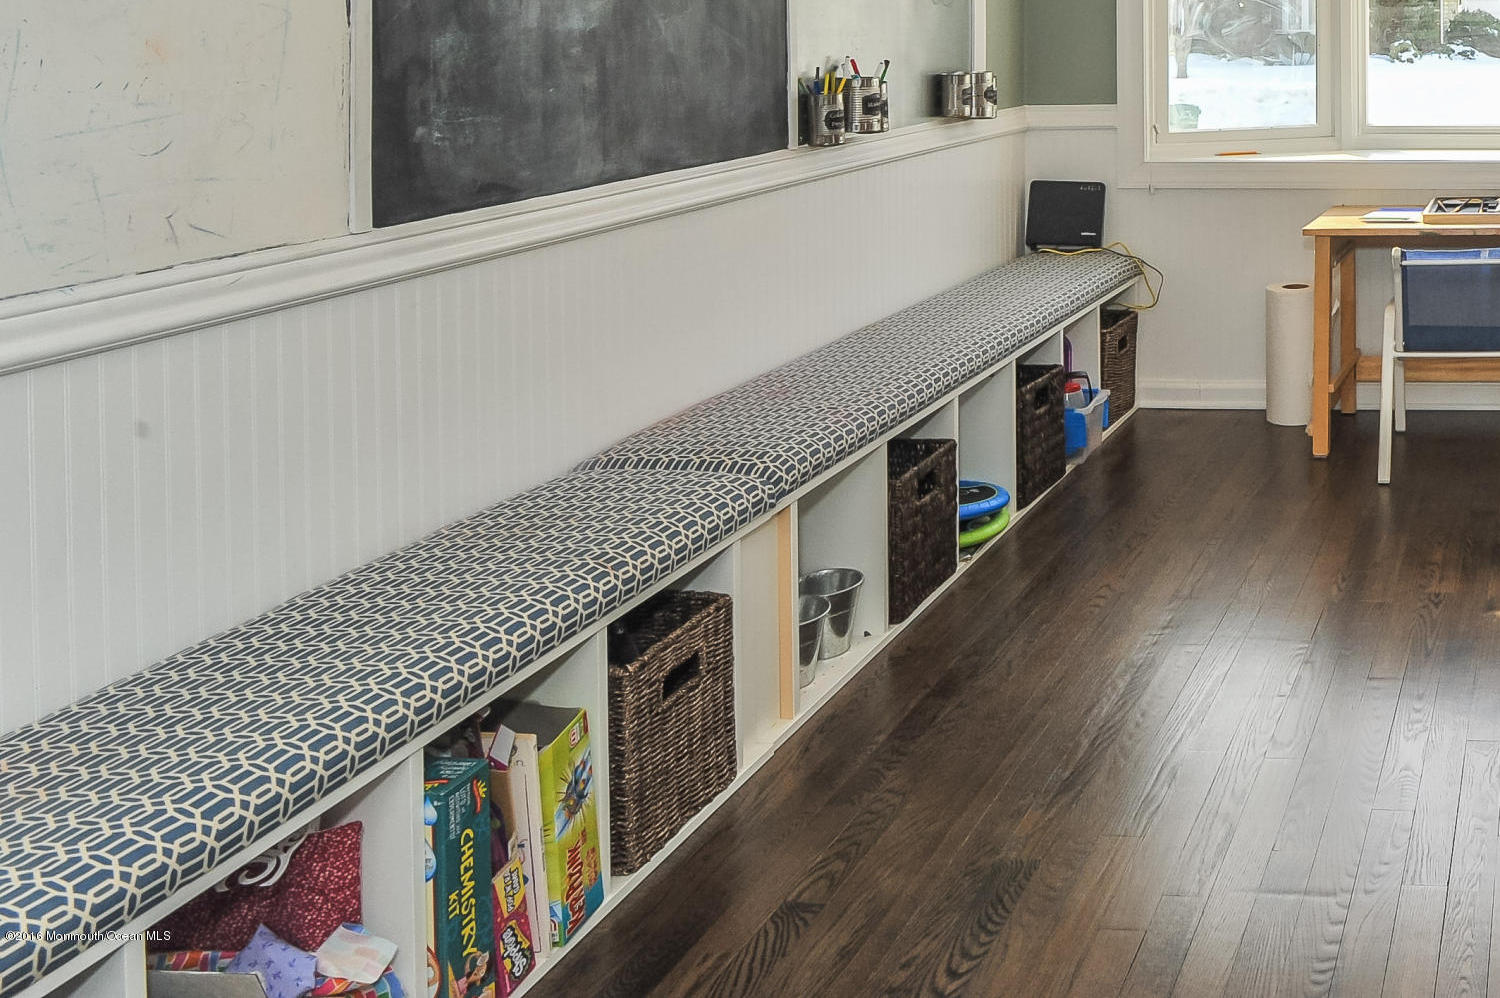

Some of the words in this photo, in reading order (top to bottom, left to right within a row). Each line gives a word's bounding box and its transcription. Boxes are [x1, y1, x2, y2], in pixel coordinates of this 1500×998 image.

[448, 890, 460, 920] KIT
[461, 828, 478, 957] CHEMISTRY
[502, 927, 527, 977] Shopkins
